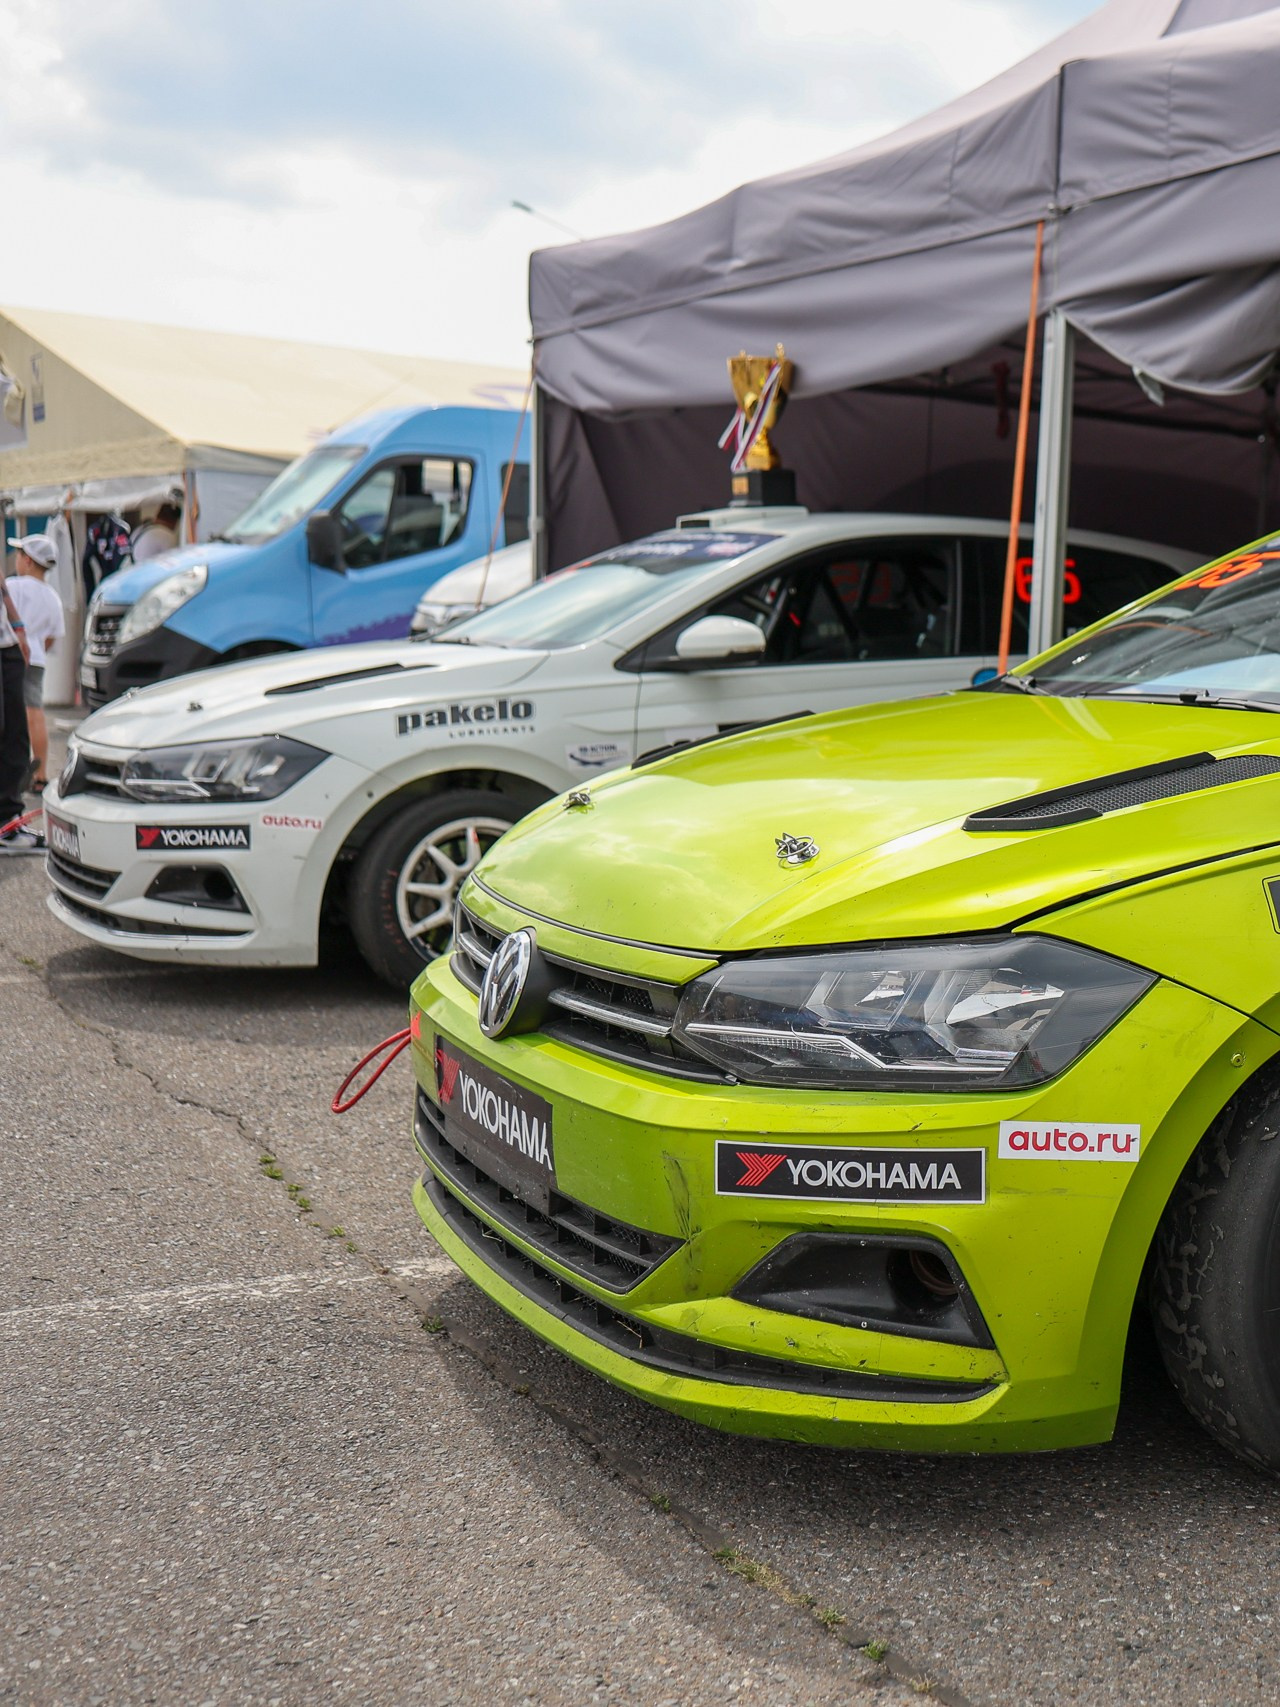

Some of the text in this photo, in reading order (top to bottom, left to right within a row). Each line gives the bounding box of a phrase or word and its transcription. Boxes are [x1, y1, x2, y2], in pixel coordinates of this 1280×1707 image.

[397, 699, 534, 735] pakelo
[450, 725, 536, 739] LUBRICANTS
[262, 814, 323, 831] auto.ru
[161, 828, 248, 848] YOKOHAMA
[459, 1069, 553, 1171] YOKOHAMA
[1008, 1128, 1136, 1154] auto.ru
[786, 1158, 962, 1190] YOKOHAMA
